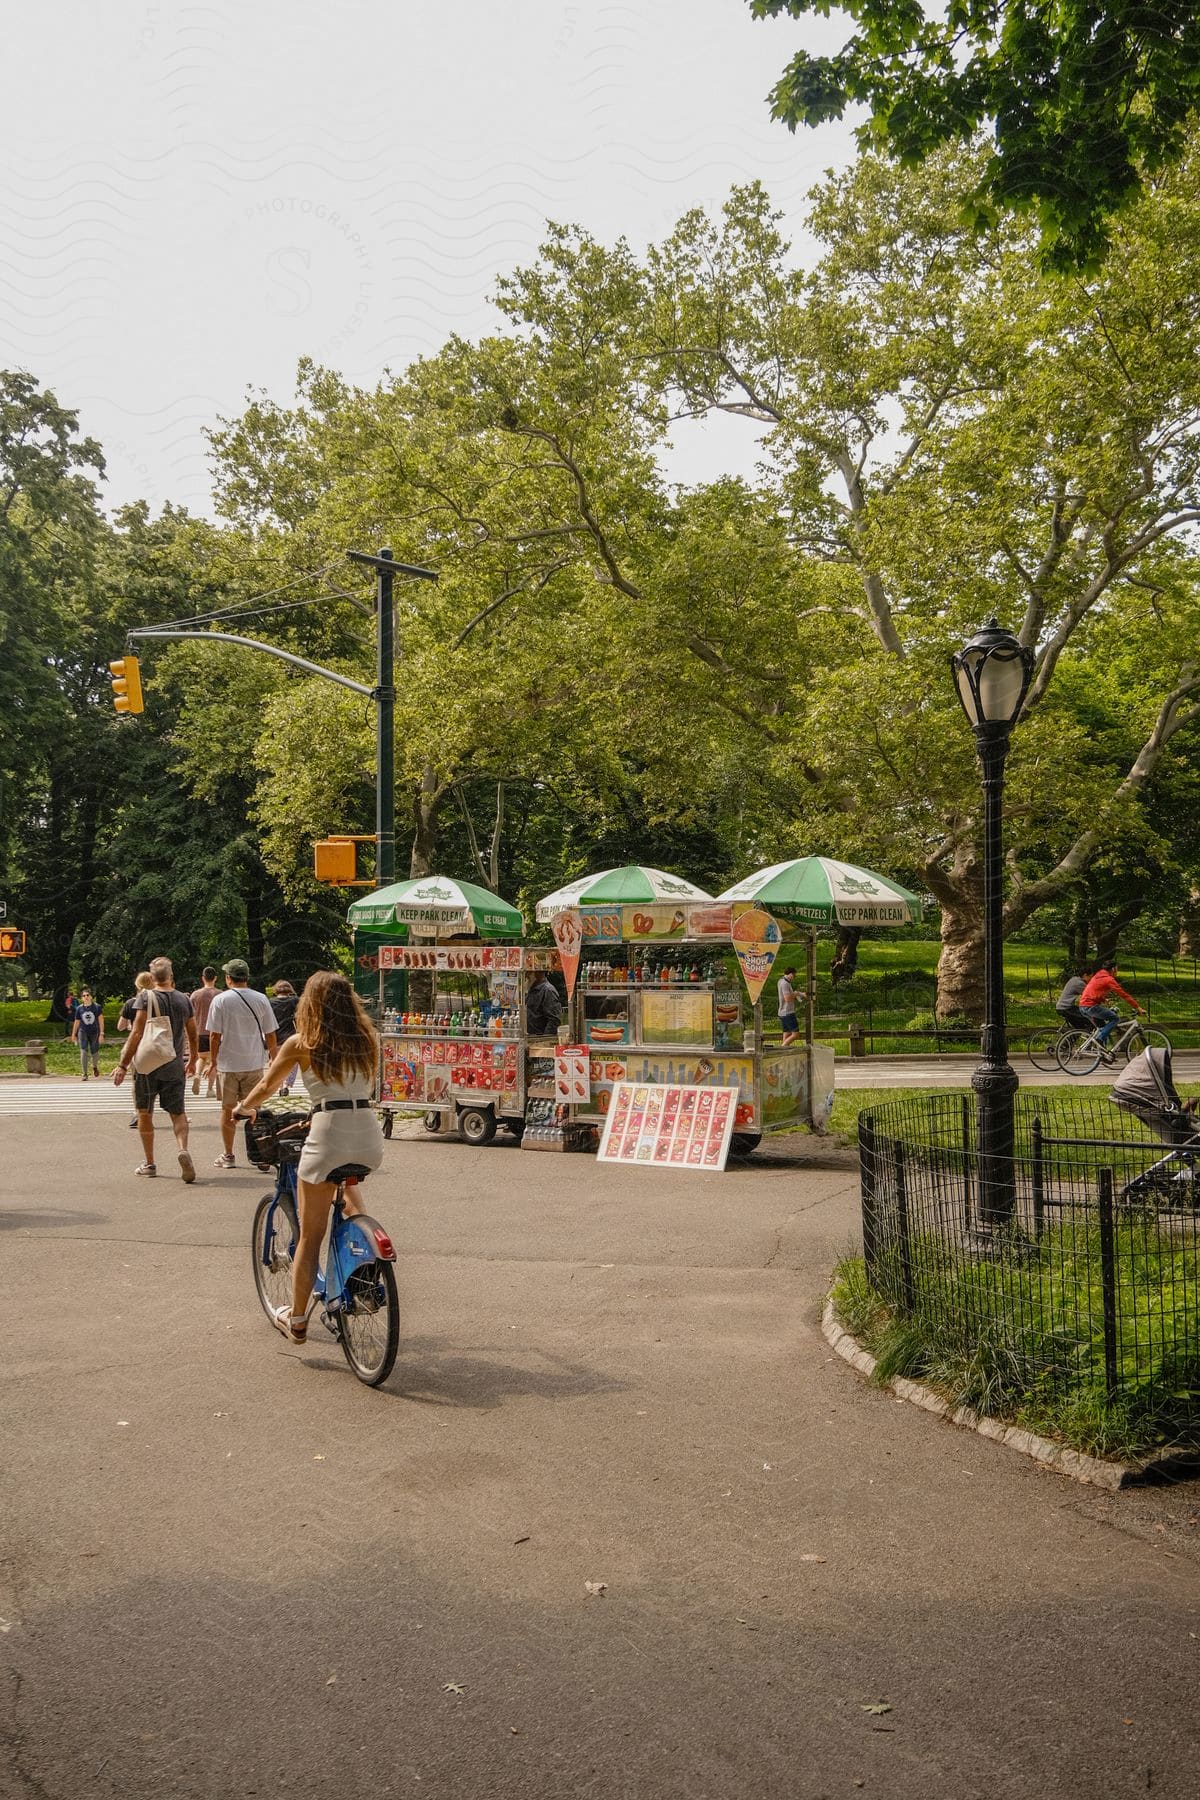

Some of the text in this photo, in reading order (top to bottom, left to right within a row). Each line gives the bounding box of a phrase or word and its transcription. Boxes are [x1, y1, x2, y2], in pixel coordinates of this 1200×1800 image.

[400, 909, 418, 921] KEEP
[420, 910, 439, 921] PARK
[441, 910, 465, 922] CLEAN
[795, 906, 827, 920] PRETZELS
[839, 907, 903, 921] KEEP PARK CLEAN
[483, 914, 507, 926] ICE CREAM
[716, 992, 740, 1001] HOT DOG
